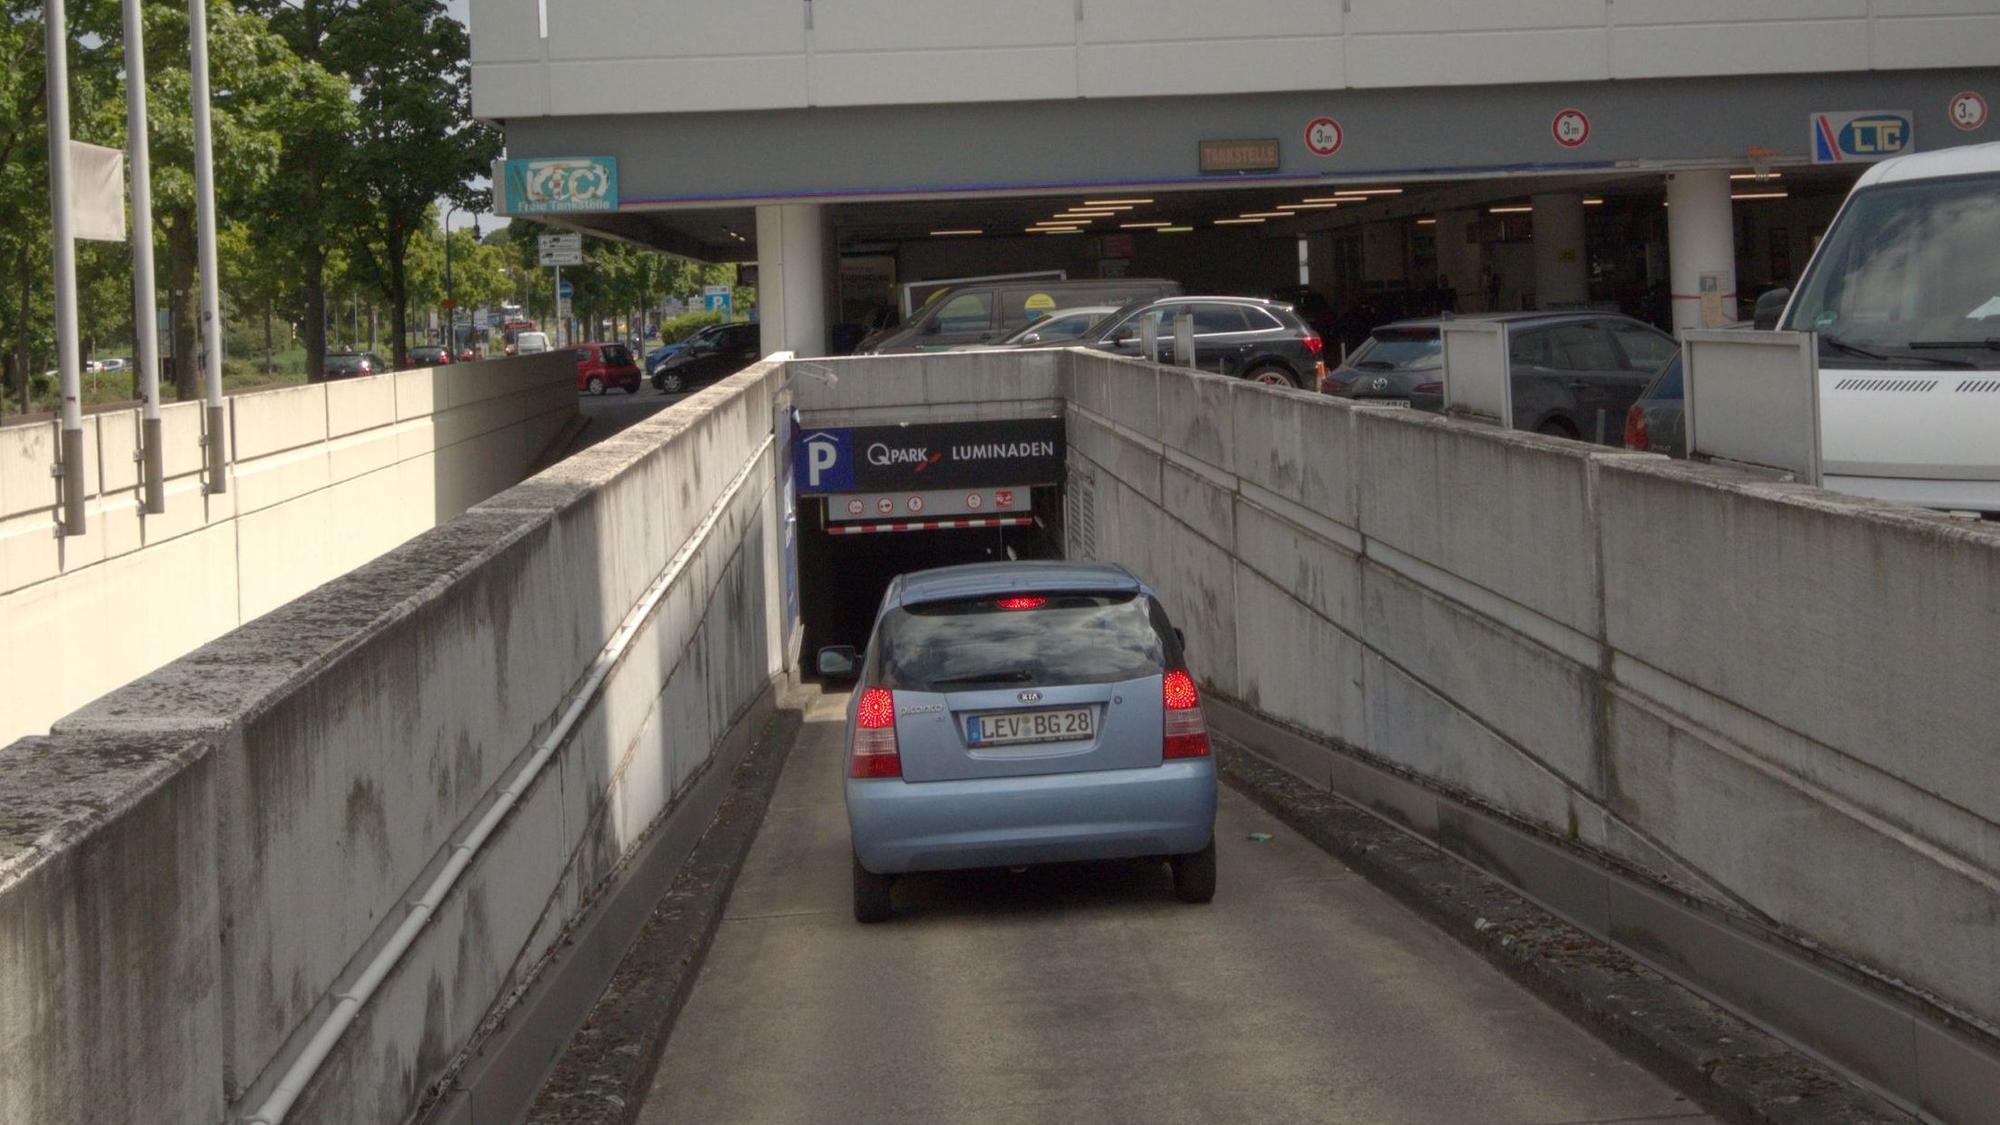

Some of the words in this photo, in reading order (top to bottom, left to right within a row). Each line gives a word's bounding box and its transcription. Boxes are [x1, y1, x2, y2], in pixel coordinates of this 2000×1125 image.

[1852, 120, 1903, 152] LTC
[551, 199, 611, 211] Tankstelle
[952, 441, 1054, 461] LUMINADEN
[808, 441, 837, 487] P
[1021, 692, 1039, 702] KIA
[981, 717, 1020, 739] LEV
[1034, 713, 1061, 735] BG
[1065, 712, 1090, 733] 28
